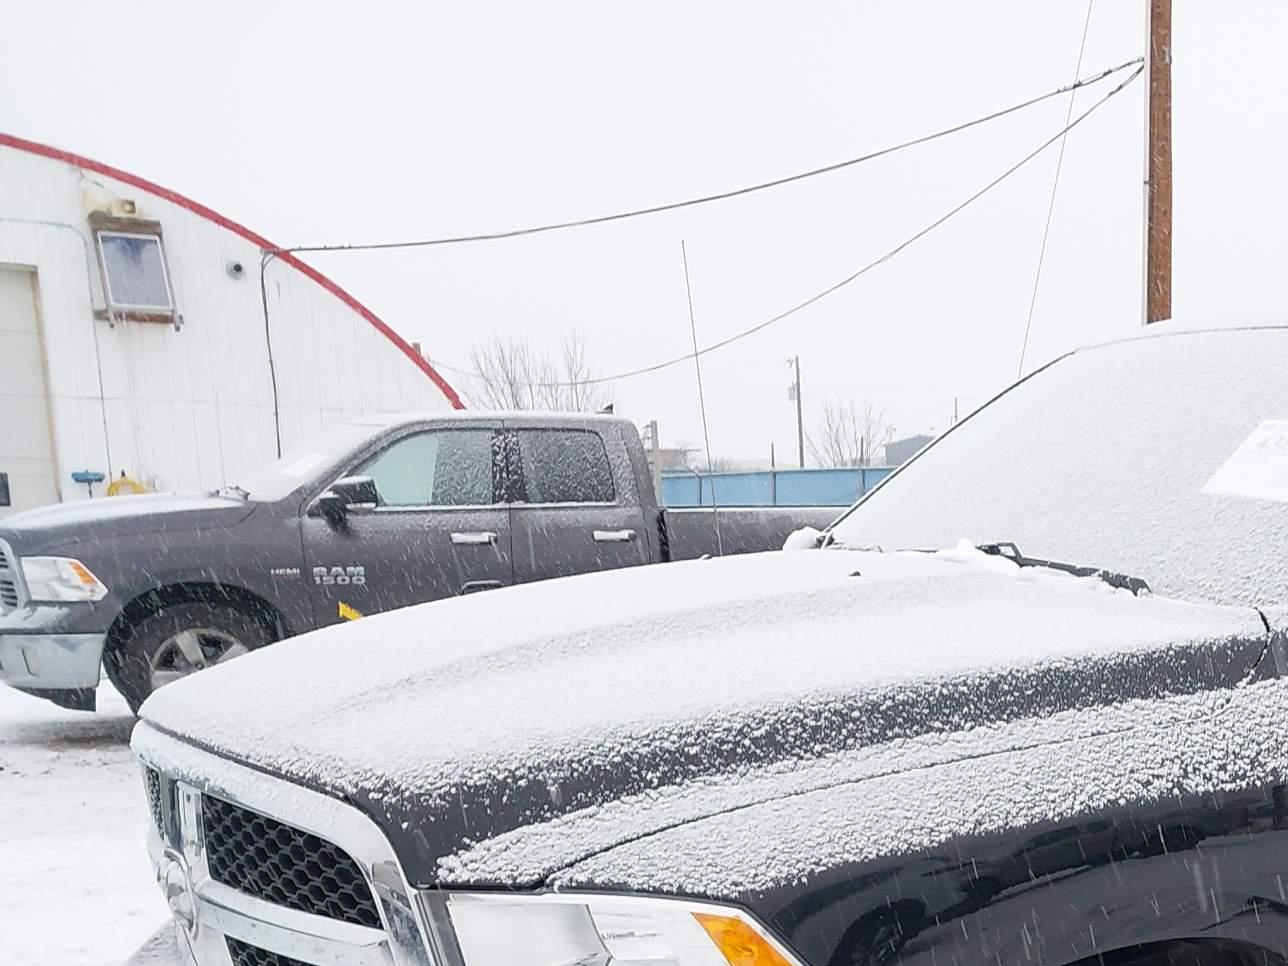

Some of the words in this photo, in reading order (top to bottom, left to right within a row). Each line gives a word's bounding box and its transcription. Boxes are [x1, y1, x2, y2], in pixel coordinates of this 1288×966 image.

[270, 567, 301, 576] HEMI
[312, 566, 365, 576] RAM
[313, 576, 366, 585] 1500
